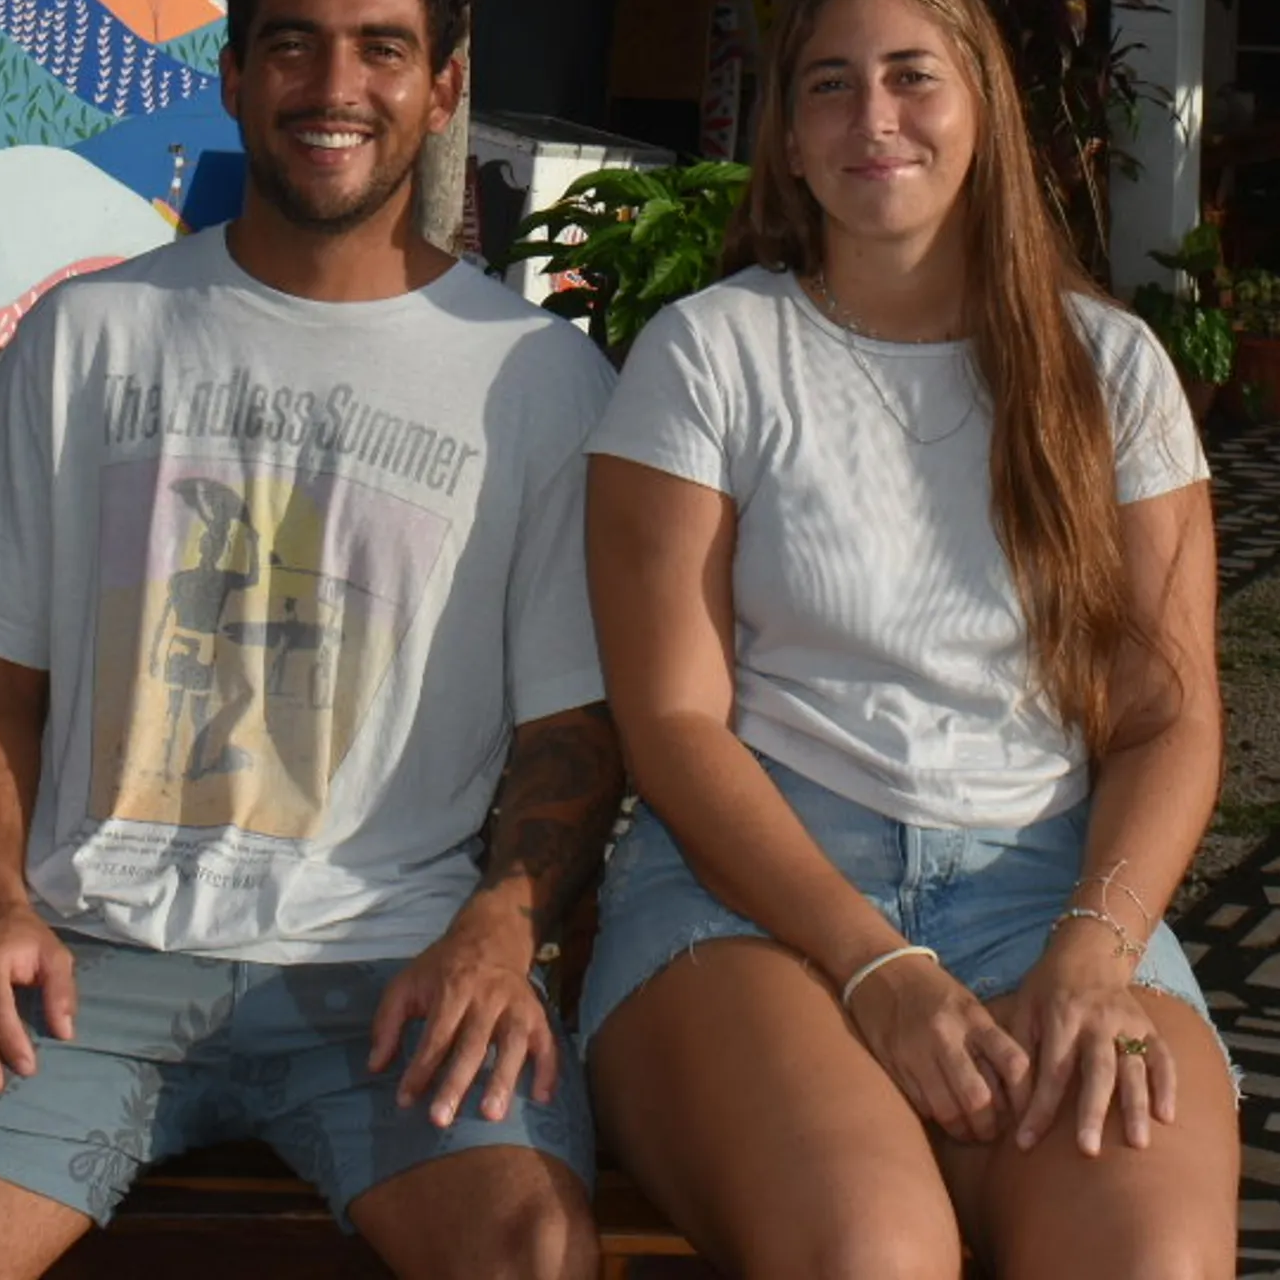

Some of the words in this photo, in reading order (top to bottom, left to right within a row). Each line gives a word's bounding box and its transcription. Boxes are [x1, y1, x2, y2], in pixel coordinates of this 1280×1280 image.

[104, 373, 162, 447] The
[166, 366, 317, 447] Endless
[315, 383, 480, 498] Summer
